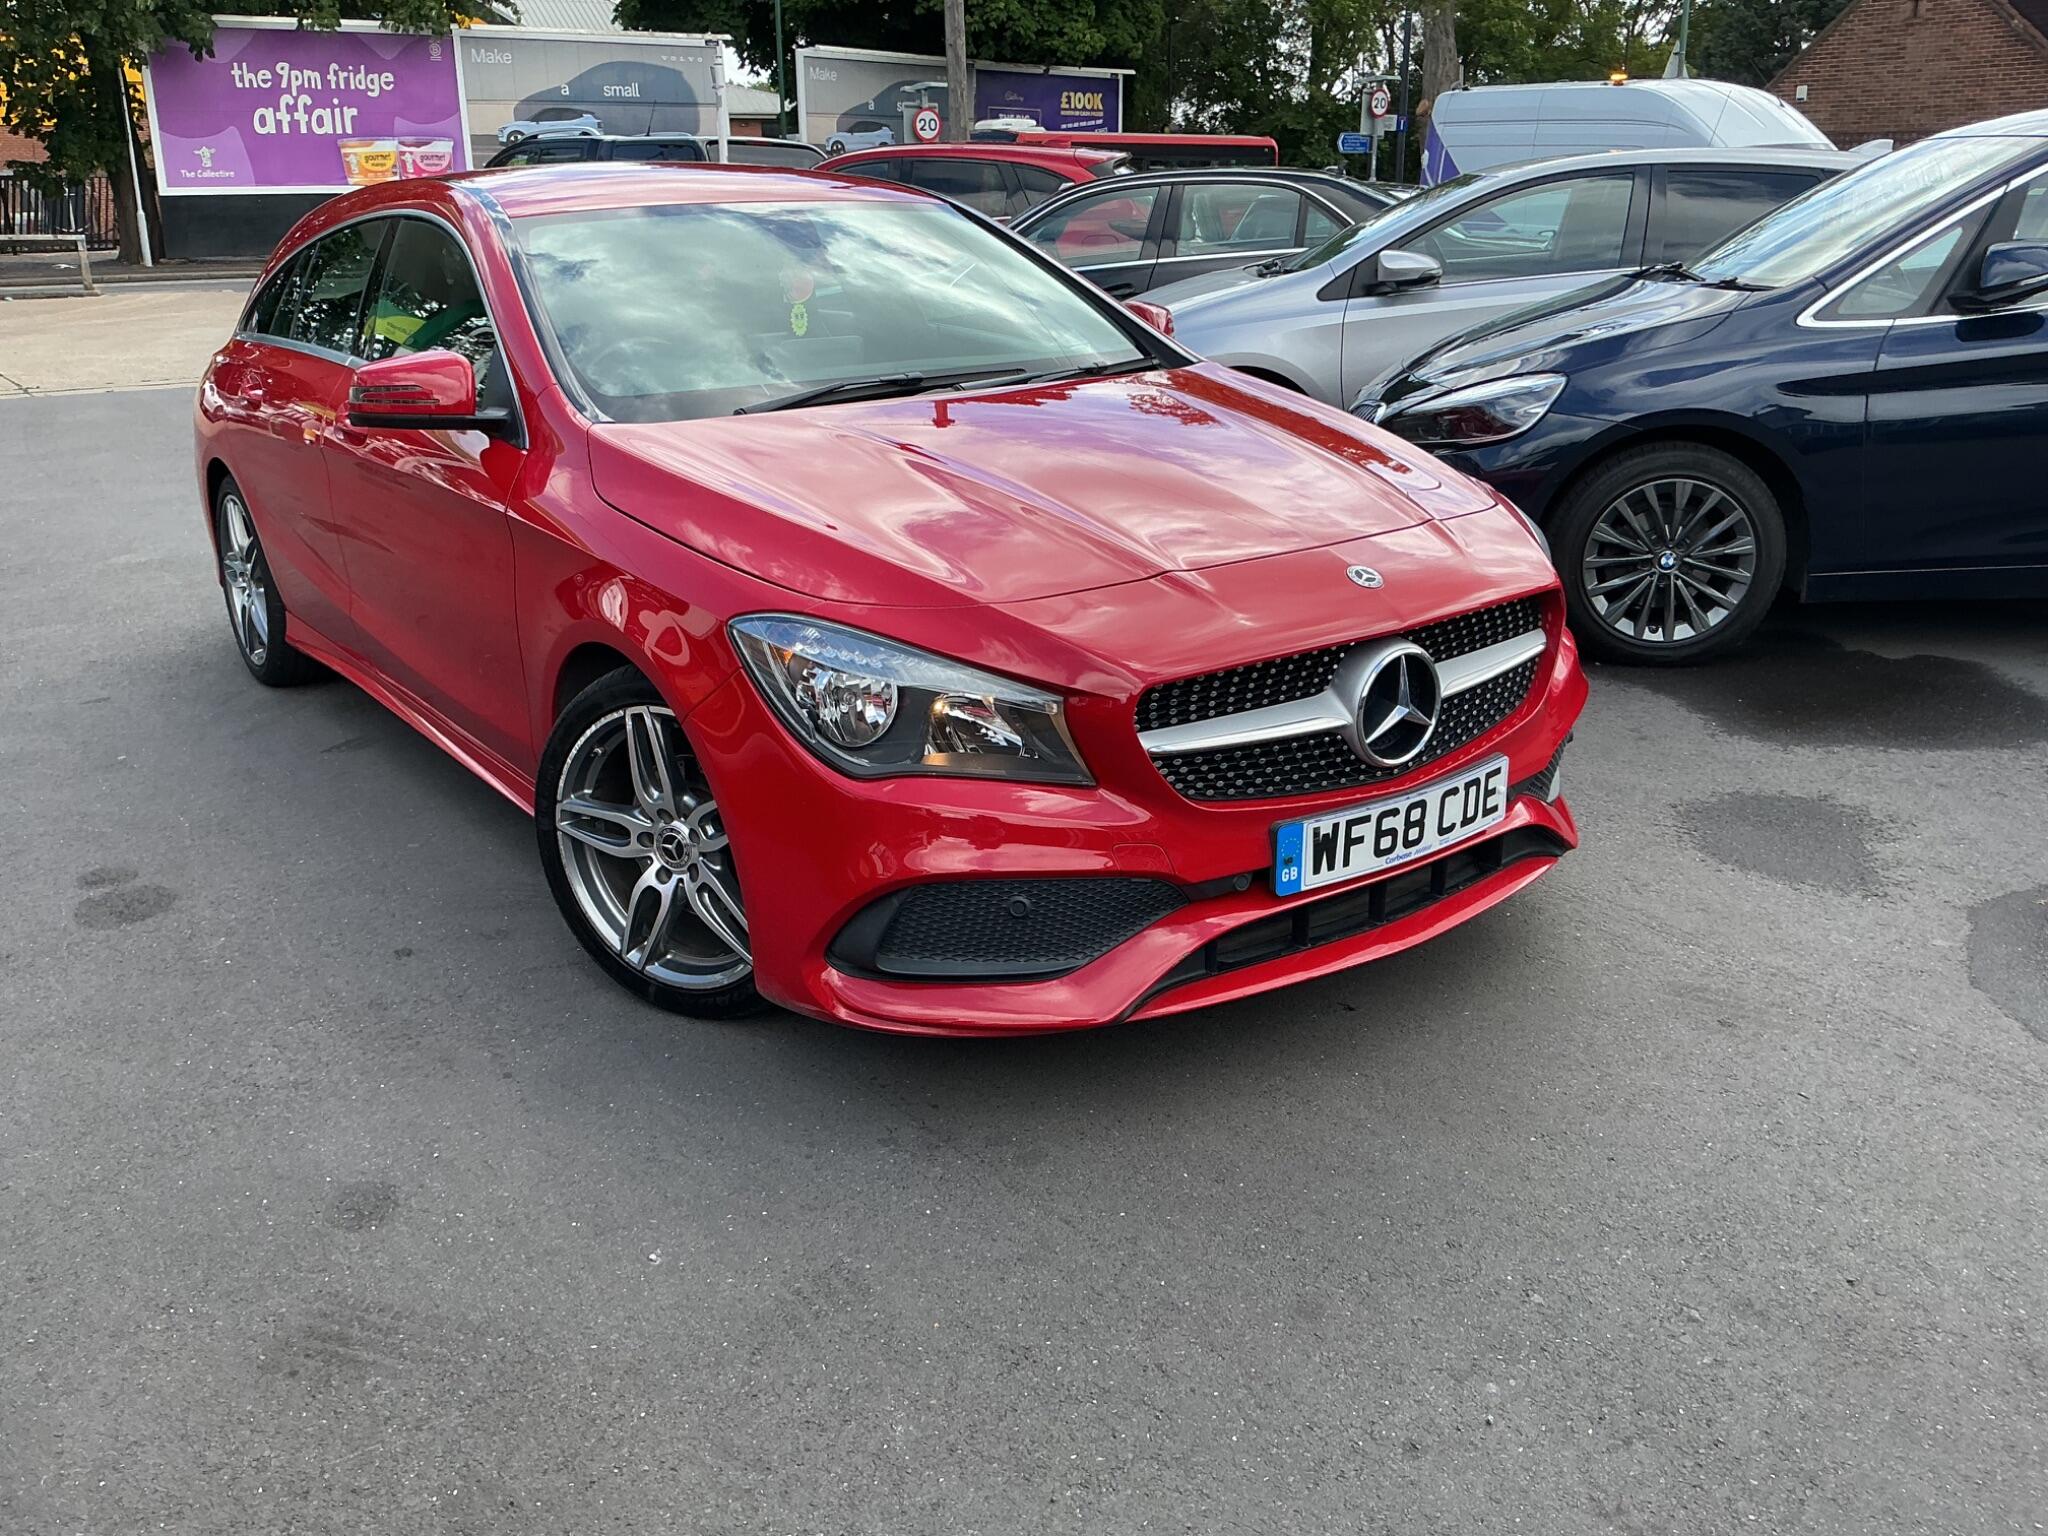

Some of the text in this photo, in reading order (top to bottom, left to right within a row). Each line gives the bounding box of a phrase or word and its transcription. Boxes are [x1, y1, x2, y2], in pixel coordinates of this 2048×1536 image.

[471, 48, 512, 64] Make
[231, 62, 394, 97] the 9pm fridge
[809, 66, 837, 81] Make
[561, 82, 640, 98] a small
[868, 100, 875, 111] a
[1060, 91, 1103, 111] £100K
[1374, 97, 1386, 109] 20
[253, 94, 358, 135] affair
[918, 118, 937, 132] 20
[364, 153, 391, 163] gourmet
[420, 153, 445, 163] gourmet
[180, 169, 235, 178] The Collective
[1312, 766, 1502, 876] WF68 CDE
[1281, 867, 1298, 882] GB
